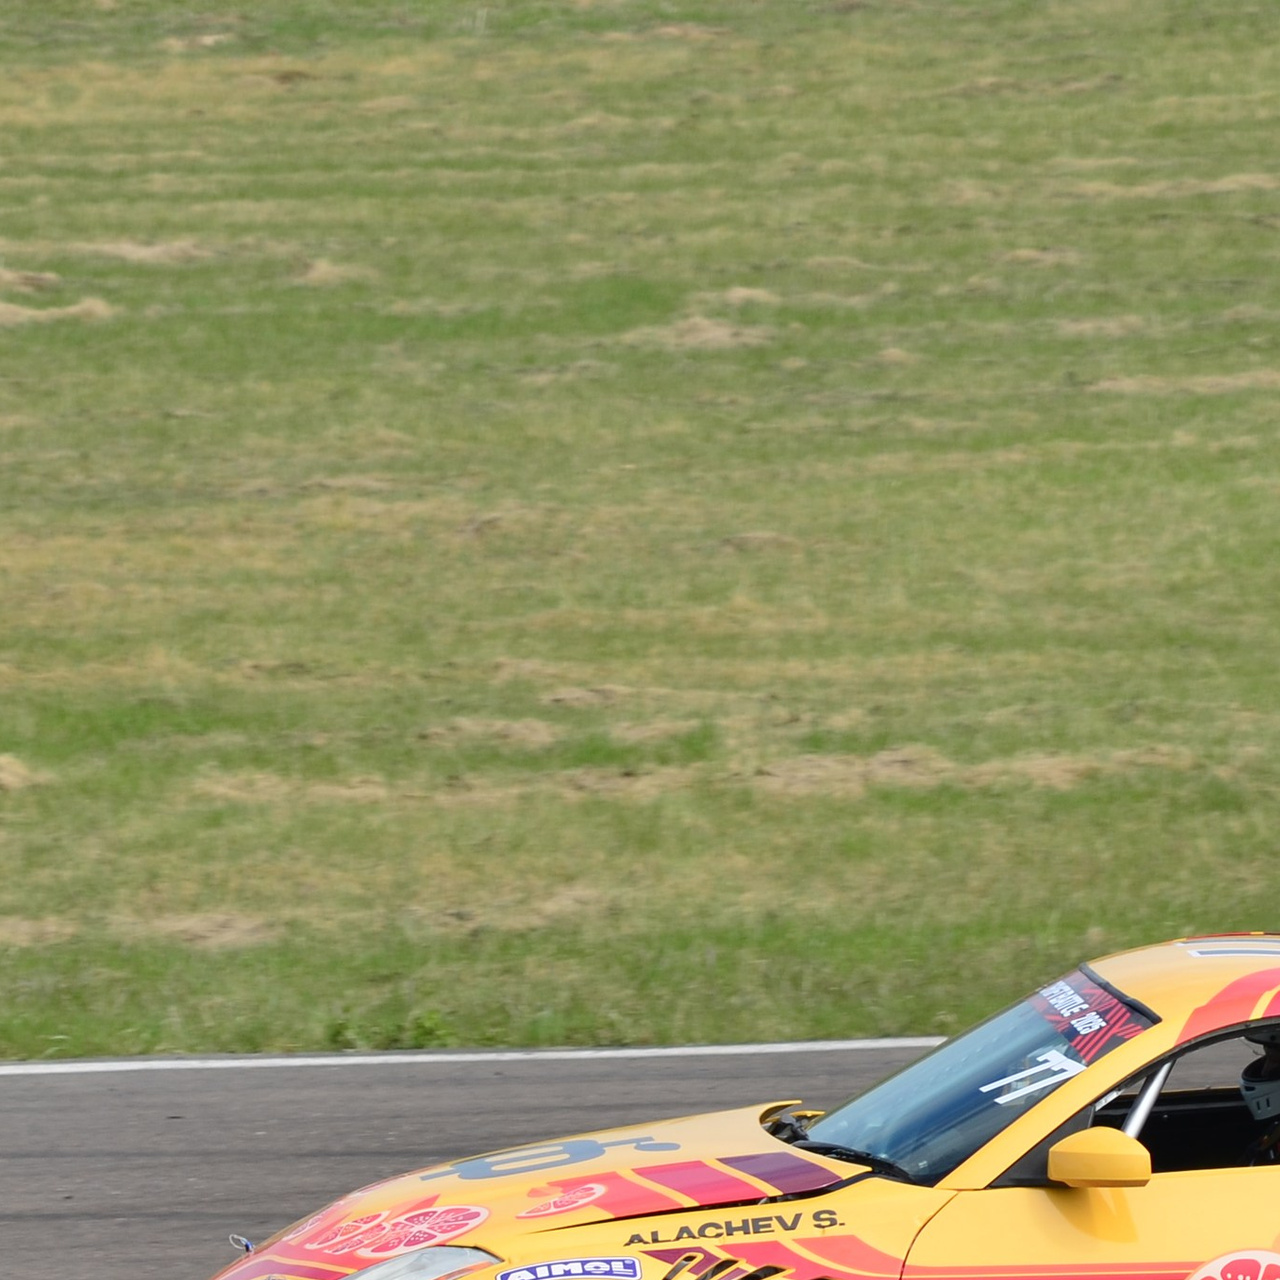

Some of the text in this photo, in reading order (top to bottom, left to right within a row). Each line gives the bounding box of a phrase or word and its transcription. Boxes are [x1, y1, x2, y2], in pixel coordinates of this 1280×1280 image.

[979, 1050, 1087, 1104] 77
[623, 1209, 846, 1247] ALACHEV S.
